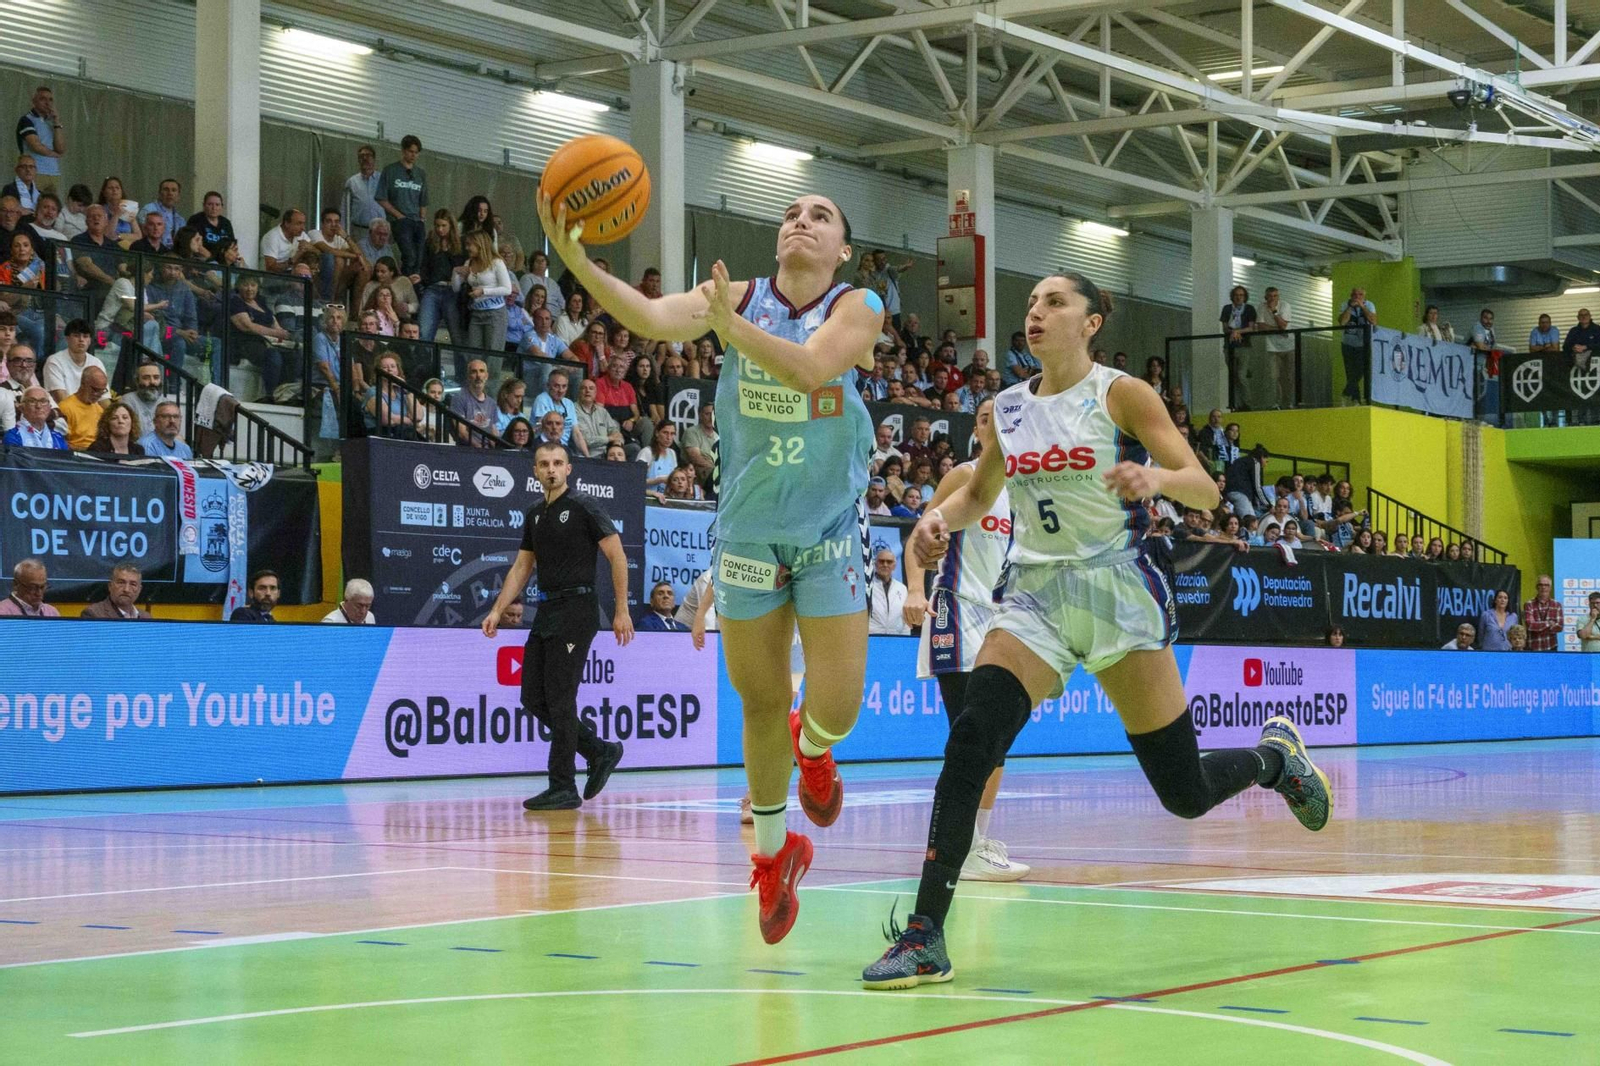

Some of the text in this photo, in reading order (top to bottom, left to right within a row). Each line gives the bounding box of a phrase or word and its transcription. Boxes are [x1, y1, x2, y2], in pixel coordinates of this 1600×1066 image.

[565, 166, 631, 212] Wilson
[687, 391, 698, 400] FEB
[742, 387, 802, 404] CONCELLO
[748, 401, 794, 415] DE VIGO
[765, 435, 805, 467] 32
[432, 469, 460, 482] CELTA
[482, 472, 507, 490] Zorka
[575, 477, 614, 499] femxa
[11, 491, 165, 525] CONCELLO
[402, 505, 431, 514] CONCELLO
[414, 513, 427, 521] VIGO
[465, 507, 490, 517] XUNTA
[1037, 498, 1061, 534] 5
[465, 518, 505, 528] DE GALICIA
[980, 515, 1012, 535] os
[31, 528, 149, 558] DE VIGO
[643, 529, 713, 550] ONCELLE
[686, 553, 696, 563] DE
[793, 535, 853, 573] ecalvi
[651, 565, 705, 586] DEPOR
[723, 558, 772, 578] CONCELLO
[725, 569, 765, 584] DE VIGO
[1263, 575, 1313, 592] Deputación
[1176, 590, 1211, 605] evedra
[1263, 593, 1313, 609] Pontevedra
[1342, 572, 1422, 621] Recalvi
[1437, 587, 1496, 617] ABANC
[1263, 661, 1303, 686] YouTube
[888, 681, 915, 716] de
[1059, 687, 1091, 722] por
[1371, 682, 1410, 717] Sigue
[1413, 682, 1425, 710] la
[1428, 683, 1444, 710] F4
[1447, 683, 1463, 709] de
[1465, 683, 1480, 709] LF
[1482, 682, 1539, 714] Challenge
[1541, 688, 1560, 713] por
[105, 691, 173, 741] por
[180, 681, 336, 728] Youtube
[1189, 692, 1348, 737] @BaloncestoESP
